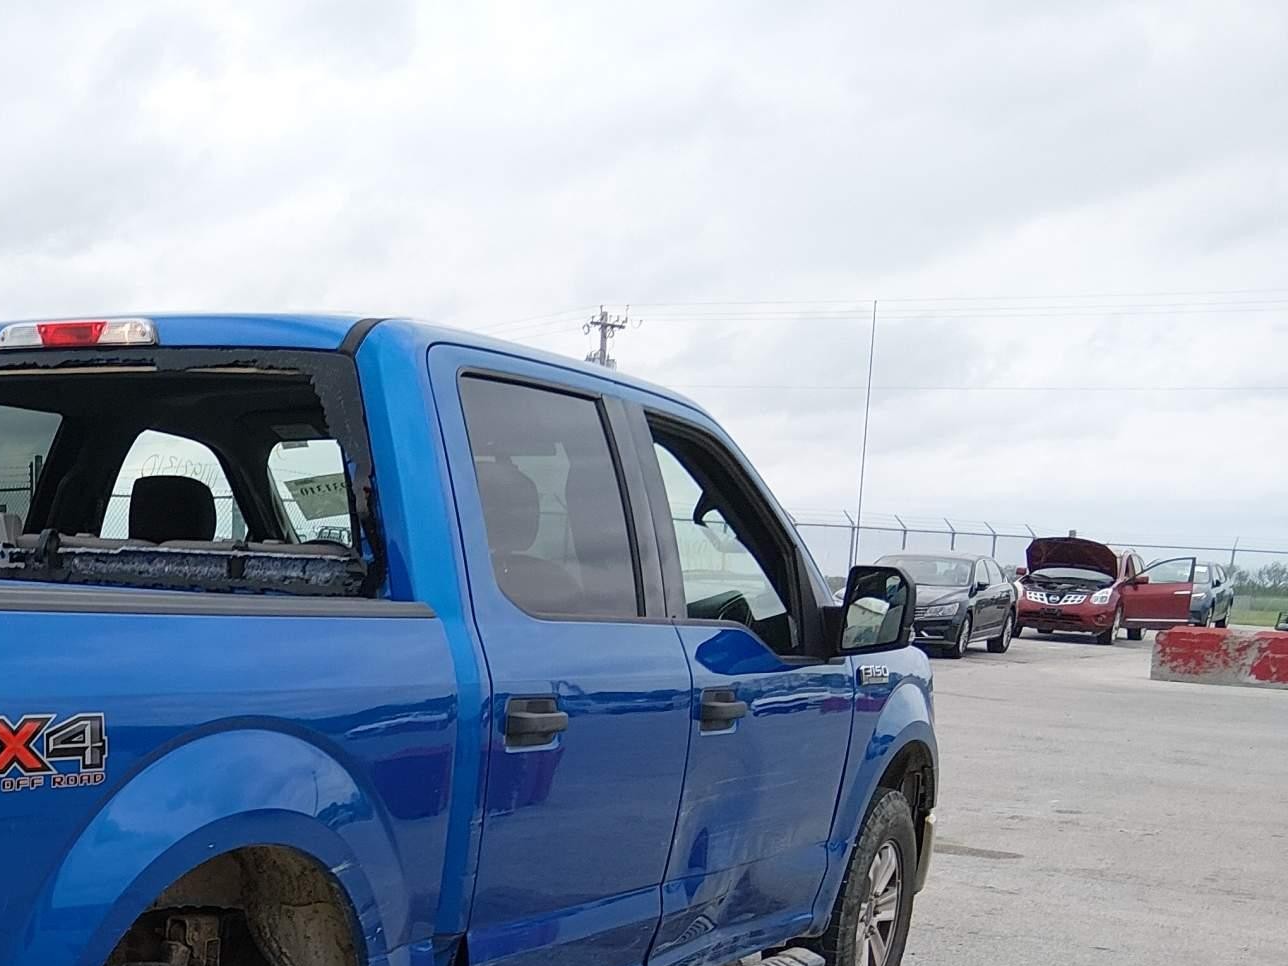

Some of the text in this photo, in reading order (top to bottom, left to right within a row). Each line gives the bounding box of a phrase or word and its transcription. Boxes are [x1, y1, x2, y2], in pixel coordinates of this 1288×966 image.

[859, 664, 889, 686] F150
[1, 772, 105, 792] OFF ROAD
